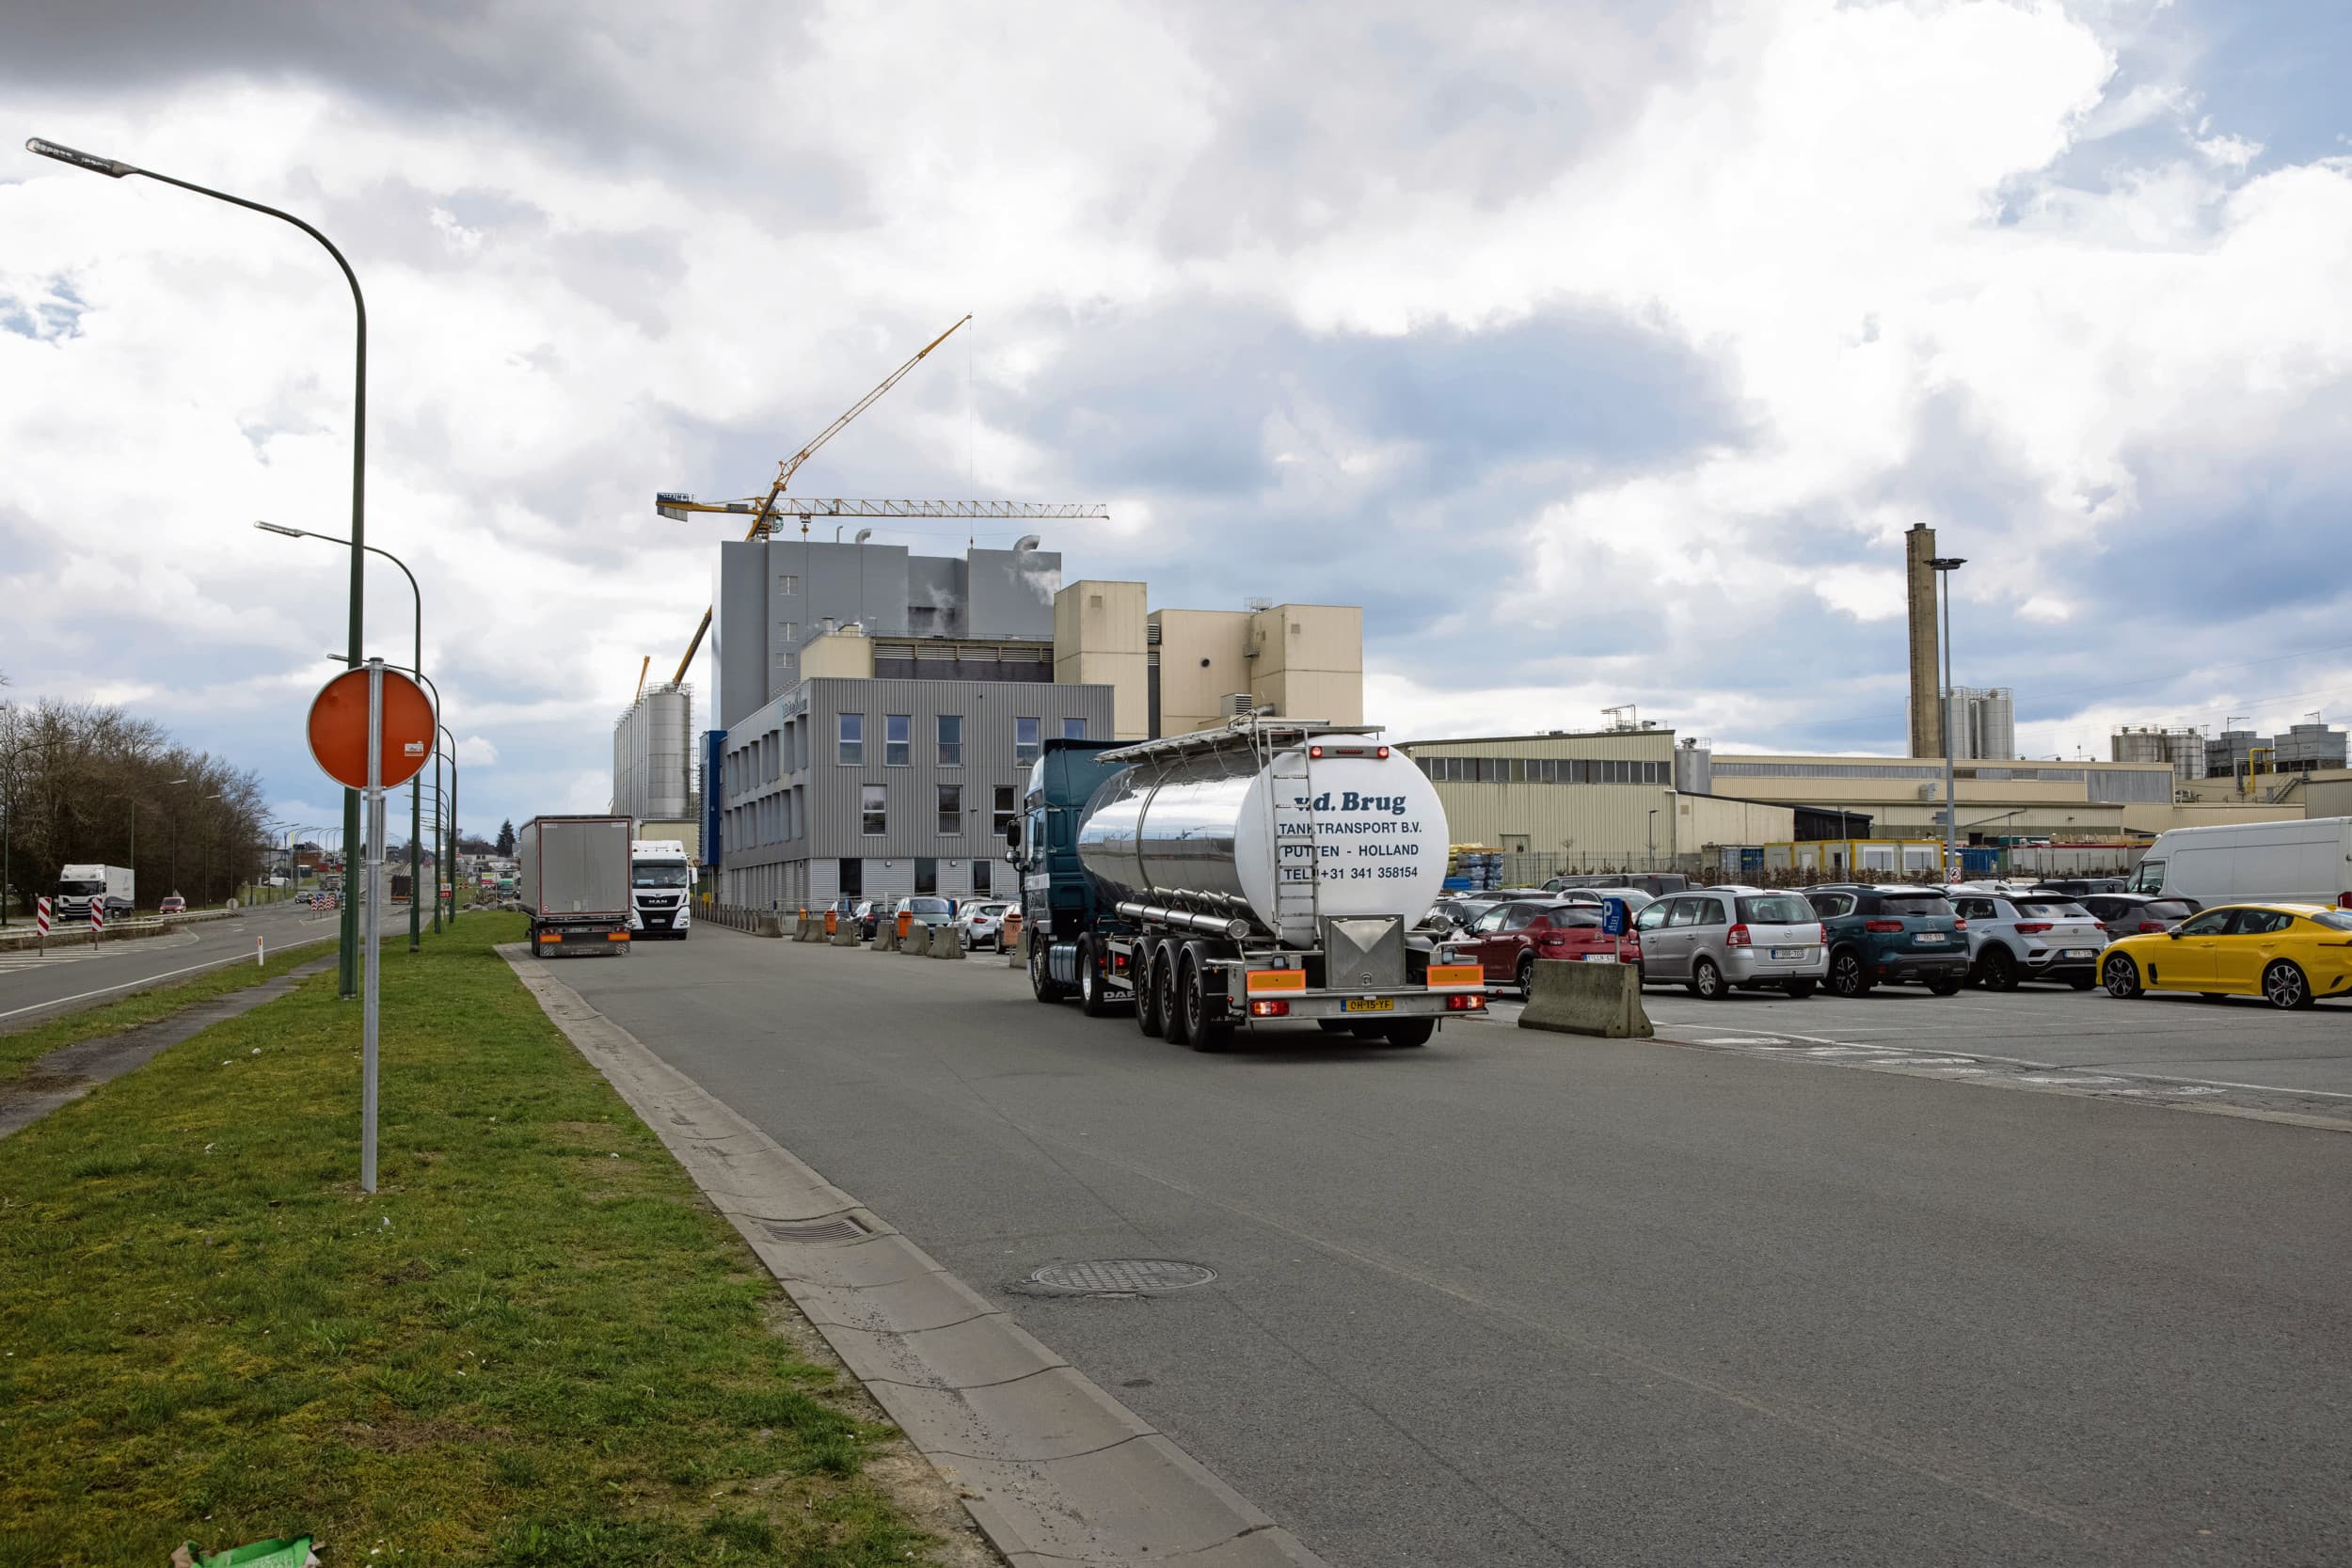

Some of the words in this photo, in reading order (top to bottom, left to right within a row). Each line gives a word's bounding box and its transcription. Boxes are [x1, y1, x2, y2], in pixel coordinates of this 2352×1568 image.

[1341, 792, 1406, 816] Brug
[1402, 821, 1422, 833] B.V.
[1284, 845, 1340, 857] PUTEN
[1359, 844, 1419, 856] HOLLAND
[1321, 868, 1344, 879] +31
[1351, 867, 1372, 879] 341
[1377, 866, 1418, 878] 358154
[1603, 901, 1613, 927] P
[1103, 990, 1136, 999] DAF
